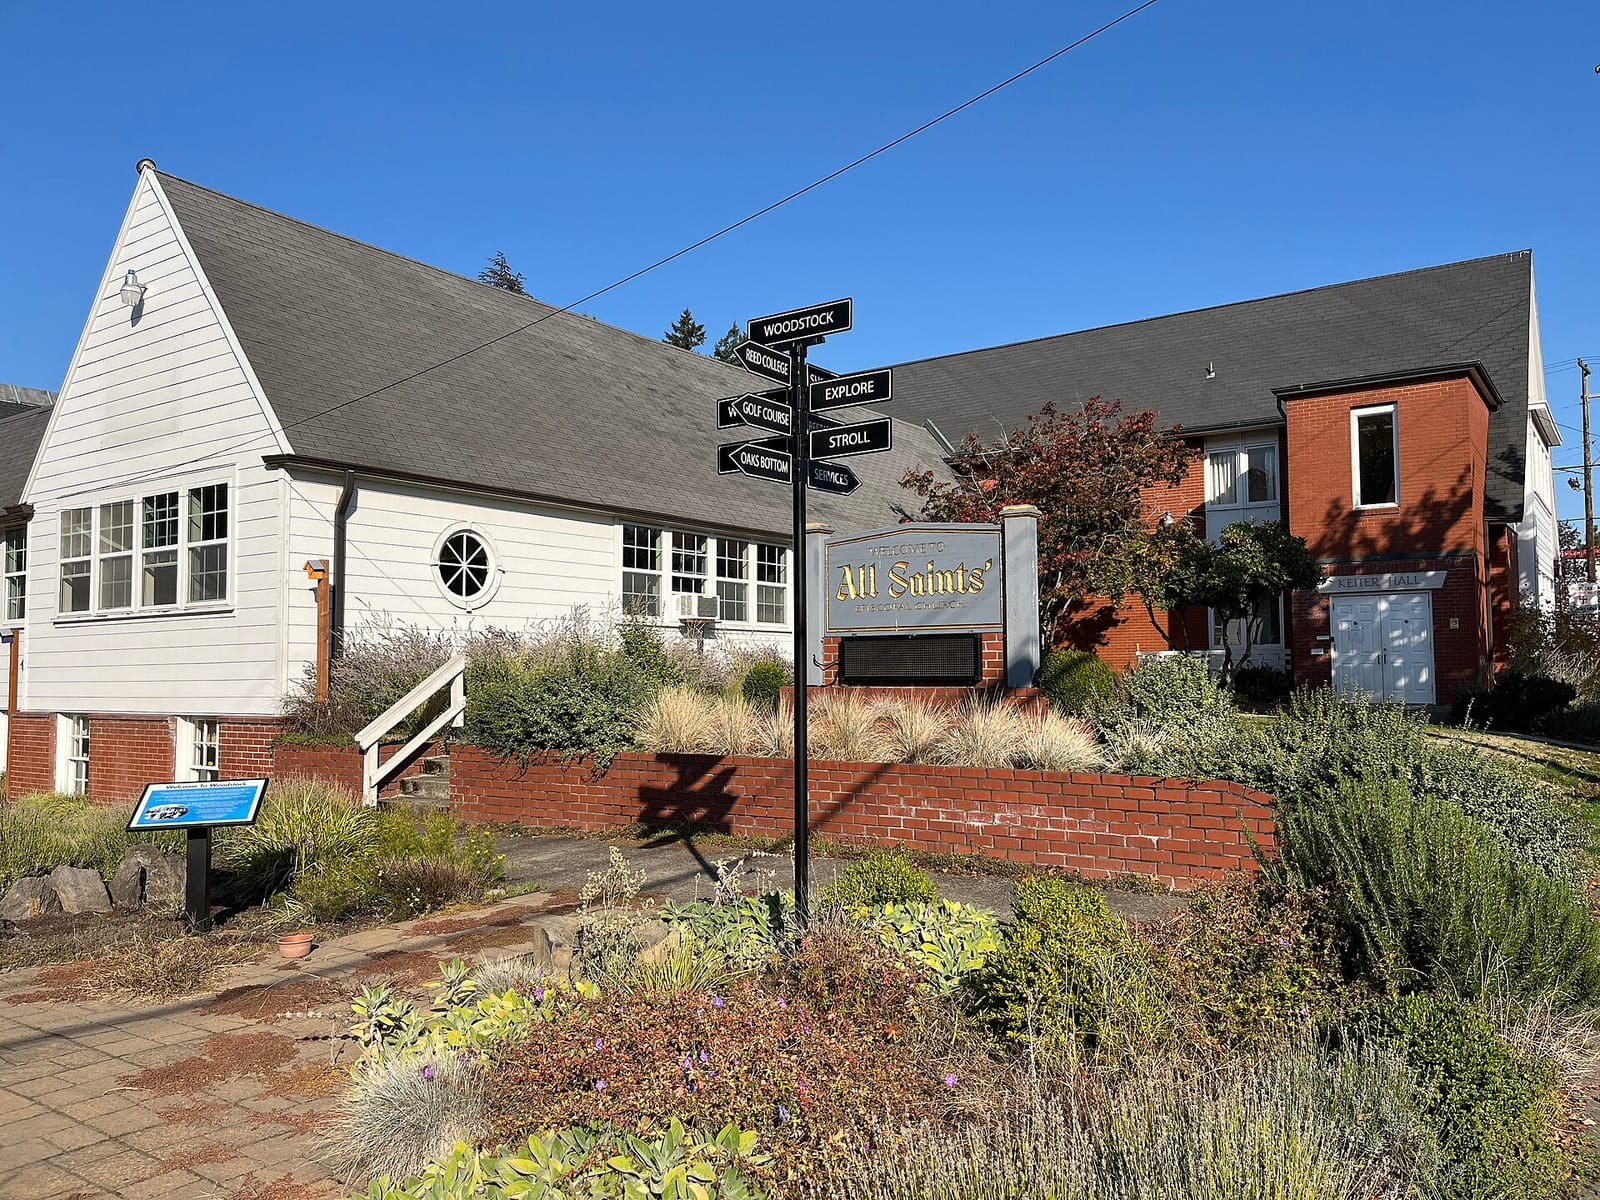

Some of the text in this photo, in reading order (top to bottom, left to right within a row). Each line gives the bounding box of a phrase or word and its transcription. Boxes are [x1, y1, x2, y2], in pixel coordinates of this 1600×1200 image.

[763, 310, 834, 337] WOODSTOCK
[745, 348, 789, 376] REED COLLEGE
[825, 380, 875, 401] EXPLORE
[742, 401, 763, 419] GOLF
[762, 407, 789, 426] COURSE
[829, 434, 871, 449] STROLL
[740, 451, 789, 474] OAKS BOTTOM
[814, 468, 849, 486] SERVICES
[868, 541, 946, 557] WELCOME TO
[835, 557, 993, 601] All Saints'
[1337, 575, 1422, 589] KEITER HALL
[855, 599, 967, 613] EPISCOPAL CHURCH
